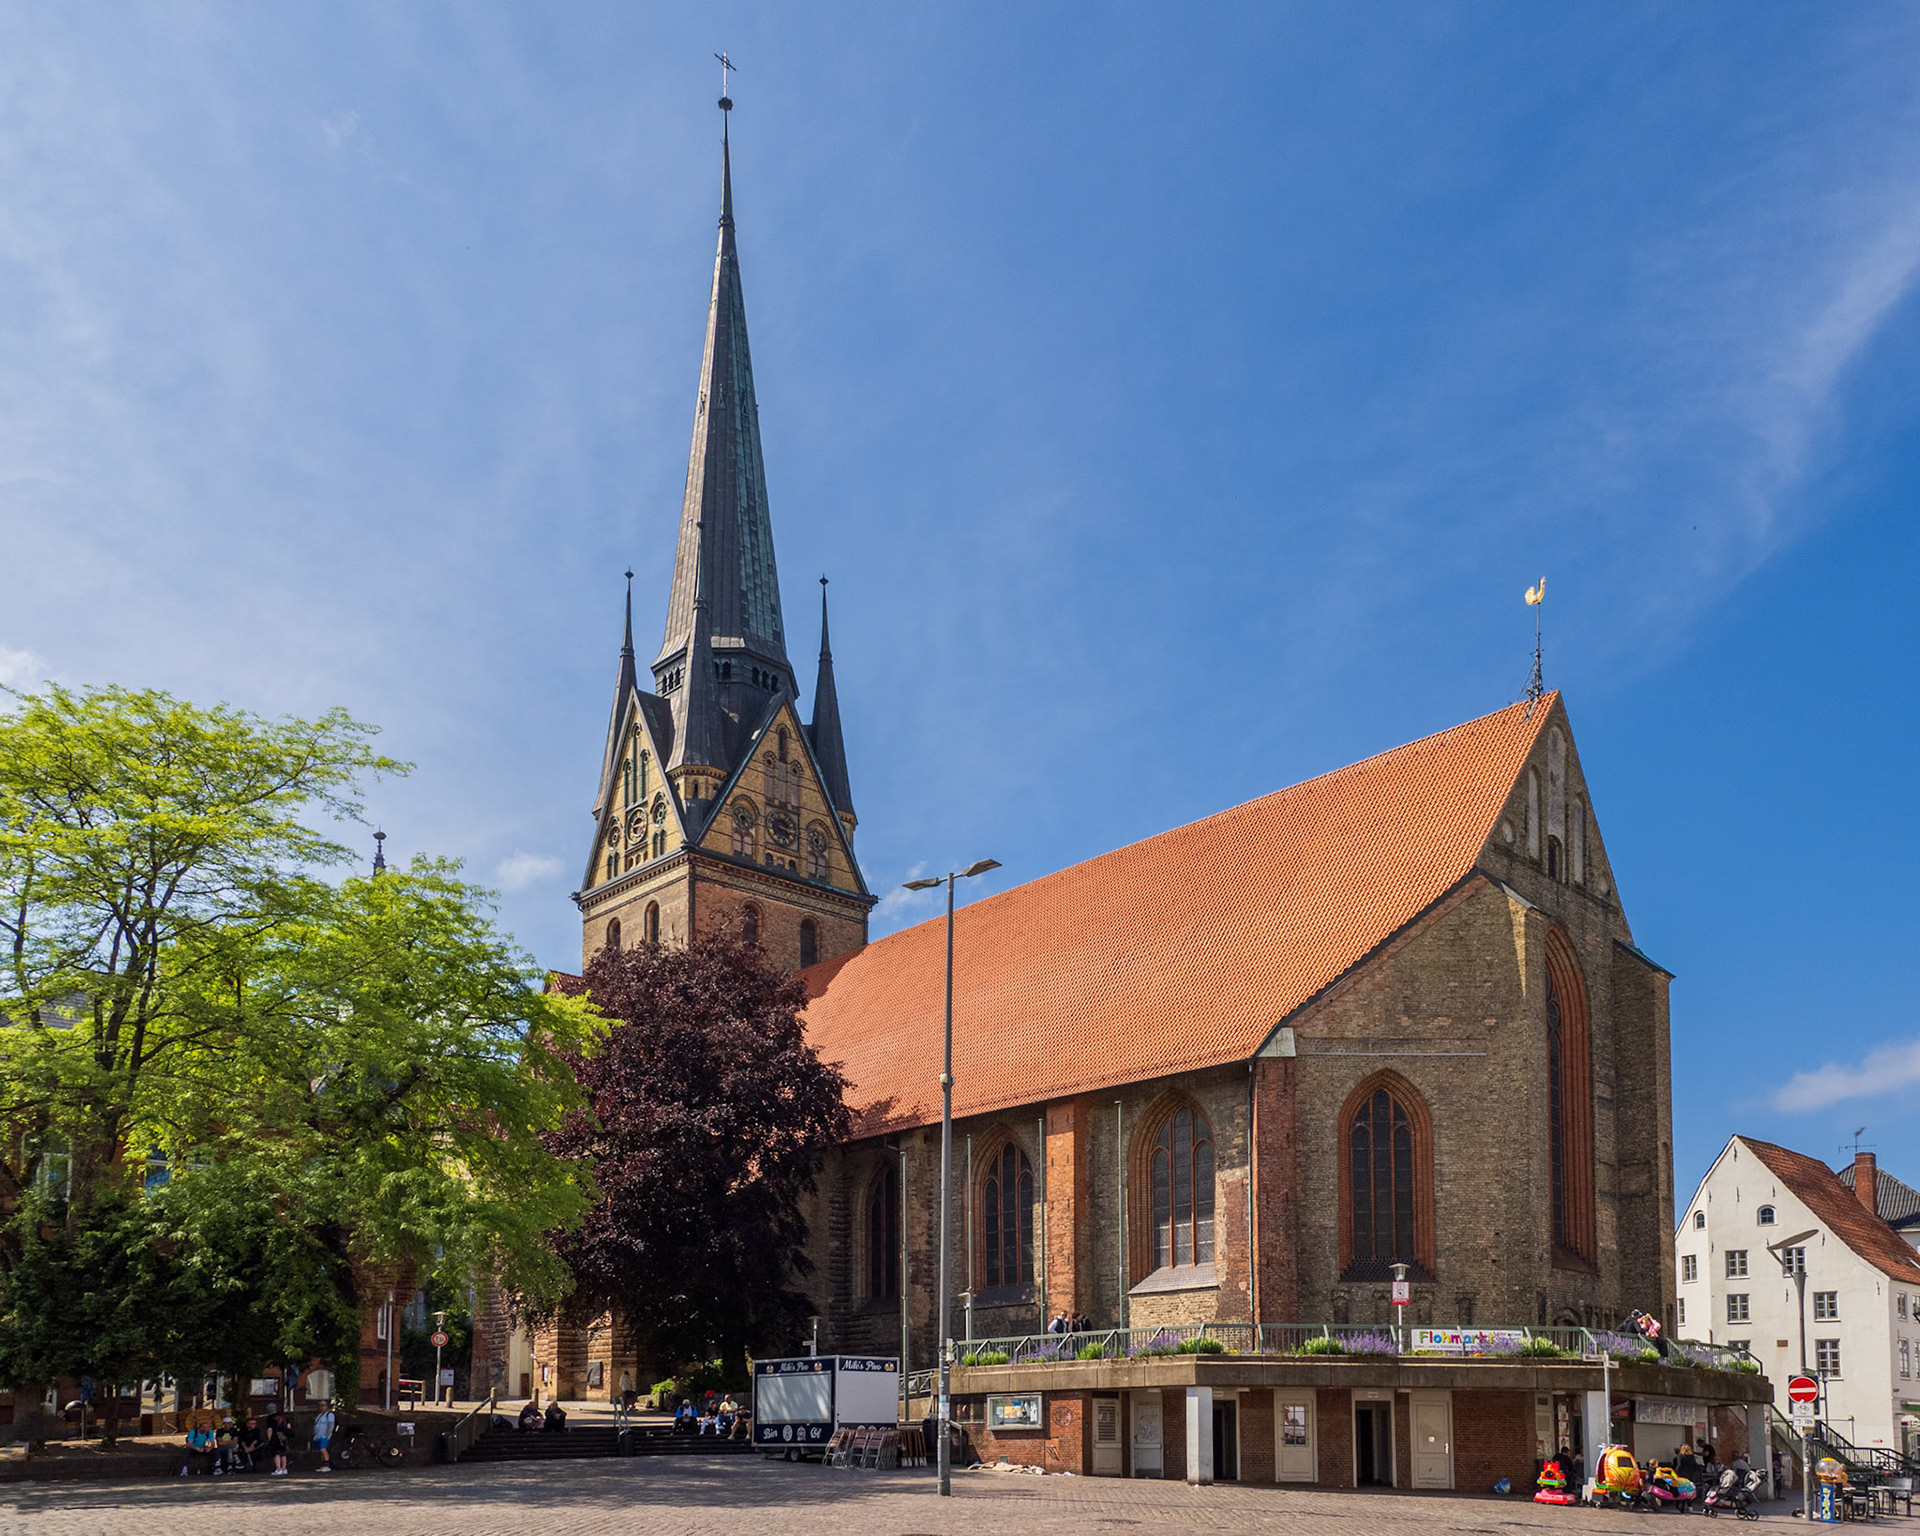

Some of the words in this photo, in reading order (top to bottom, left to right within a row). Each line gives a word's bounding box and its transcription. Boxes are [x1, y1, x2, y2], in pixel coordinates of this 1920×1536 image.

[1419, 1330, 1495, 1344] Flohmarkt
[865, 1360, 882, 1371] Pivo
[763, 1427, 778, 1440] Bier
